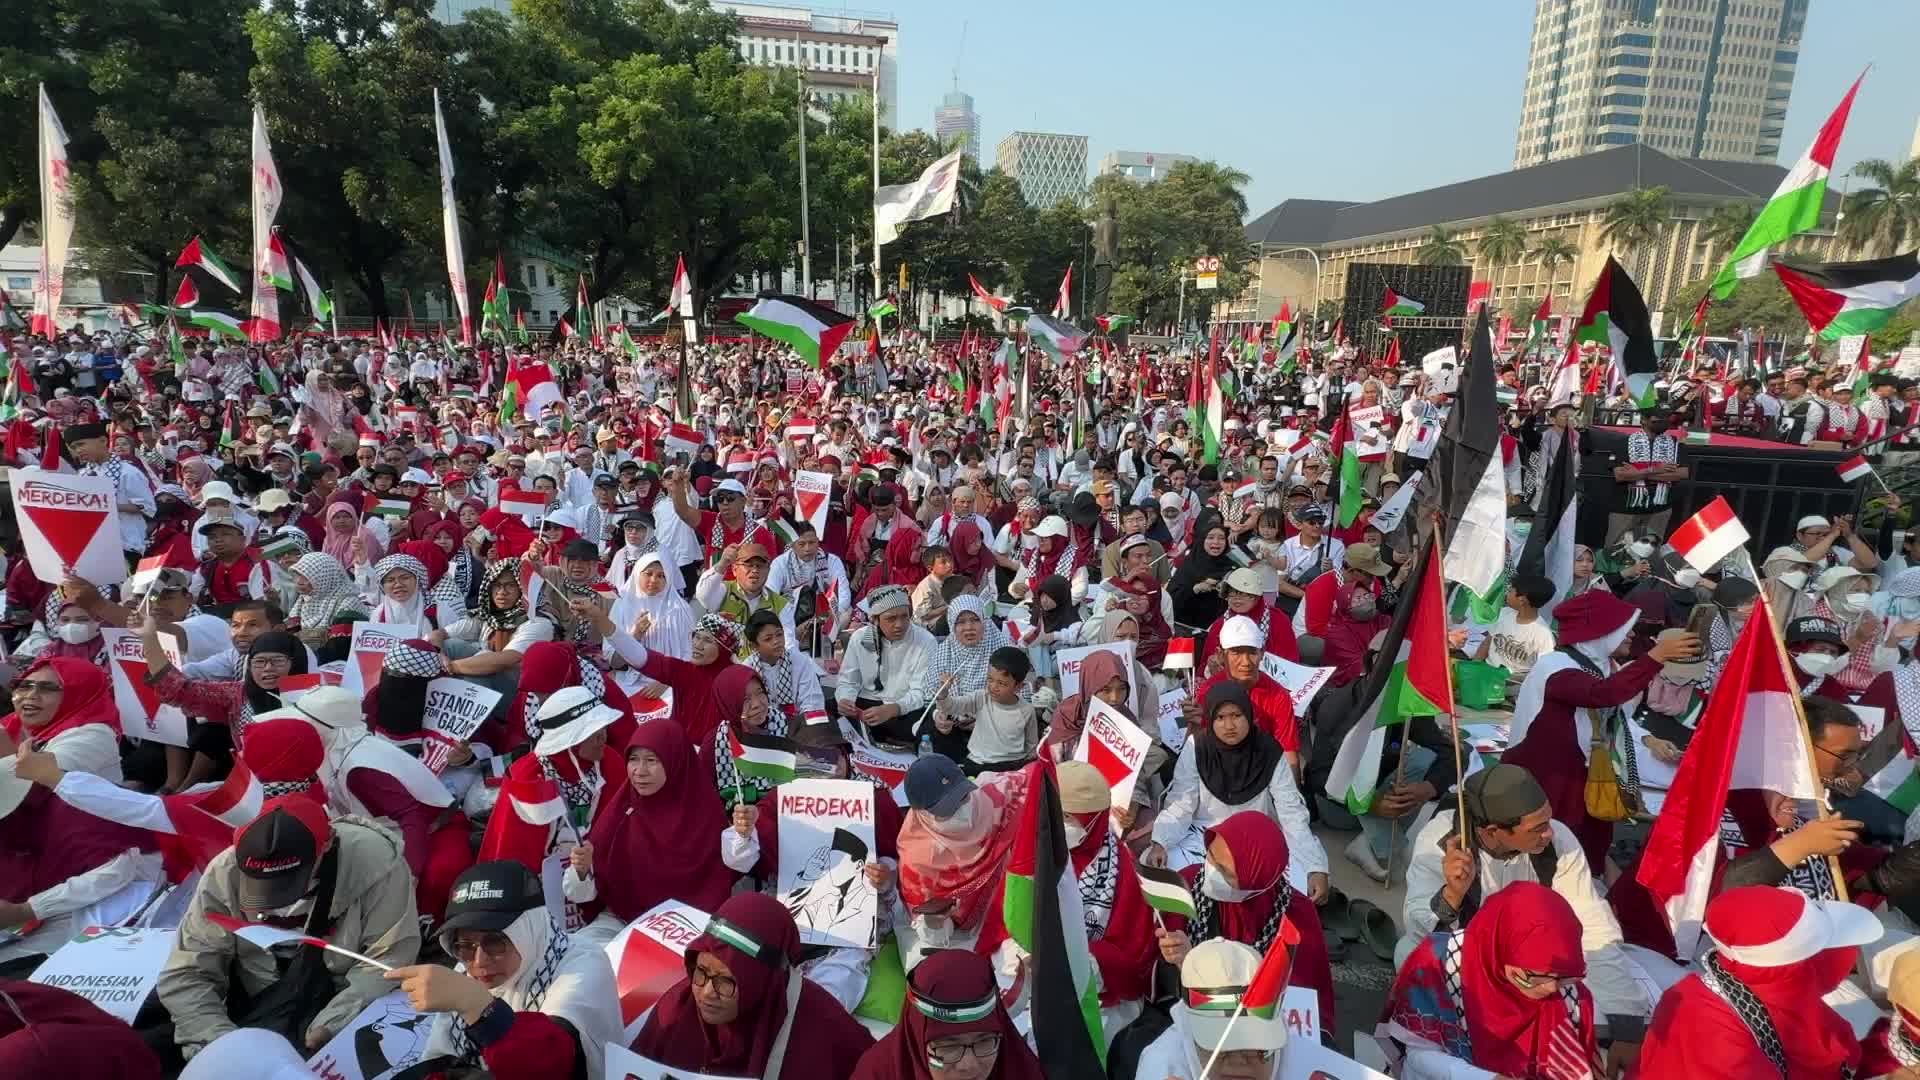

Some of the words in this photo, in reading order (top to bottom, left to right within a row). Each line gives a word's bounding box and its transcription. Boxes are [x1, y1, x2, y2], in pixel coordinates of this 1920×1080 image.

[18, 487, 109, 509] MERDEKA!
[424, 706, 439, 718] FOR
[428, 690, 474, 717] STAND
[472, 703, 489, 720] UP
[1090, 716, 1140, 766] MERDEKA!
[781, 796, 870, 821] MERDEKA!
[470, 880, 490, 890] FREE
[468, 889, 504, 900] PALESTINE
[43, 974, 144, 988] INDONESIAN
